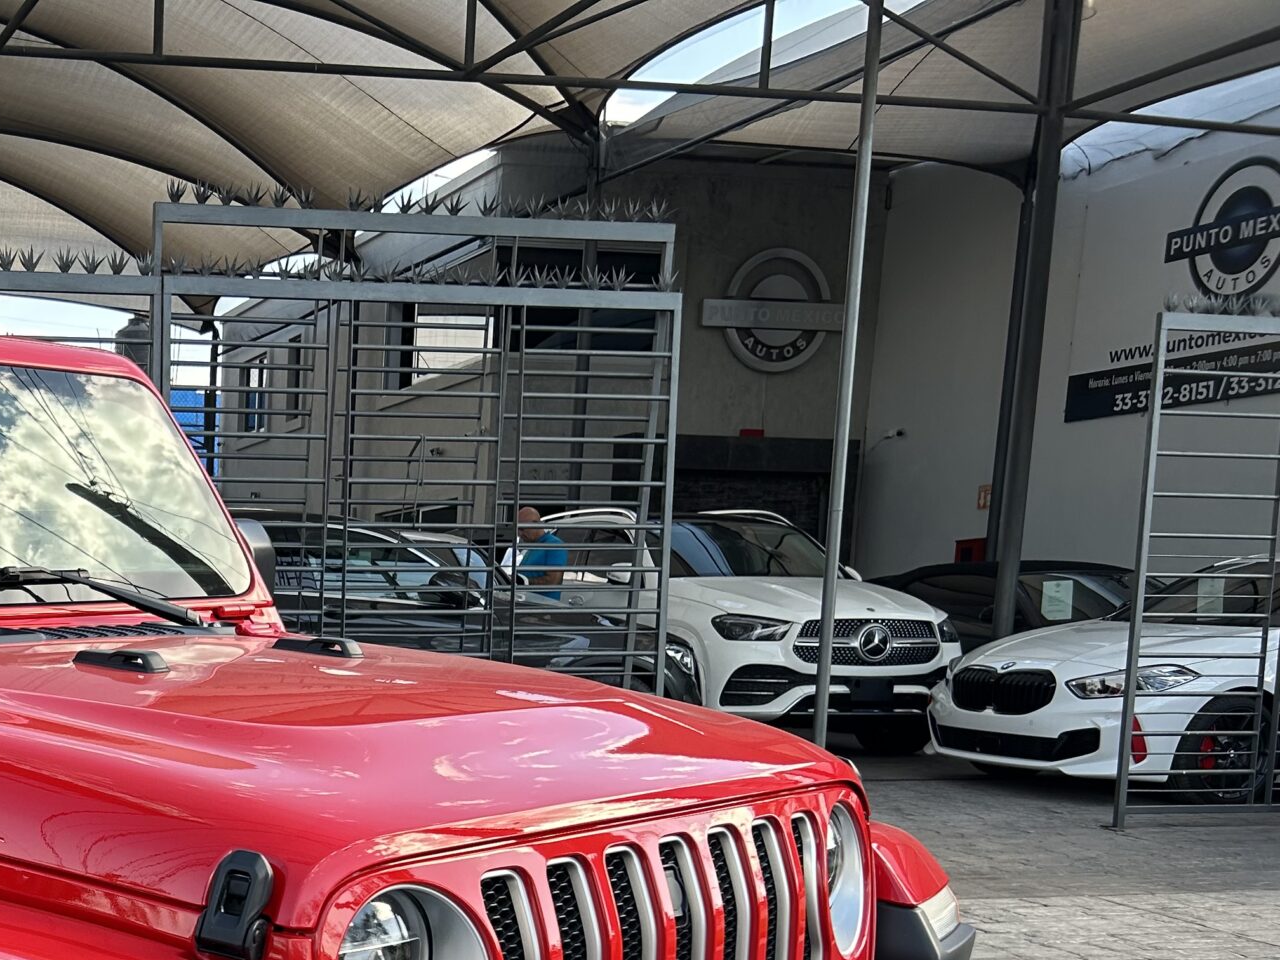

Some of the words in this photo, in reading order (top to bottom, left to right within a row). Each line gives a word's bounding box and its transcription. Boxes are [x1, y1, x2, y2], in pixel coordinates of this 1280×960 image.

[1170, 224, 1232, 256] PUNTO
[1202, 255, 1271, 291] AUTOS
[744, 335, 807, 361] AUTOS
[1111, 374, 1128, 386] Lunes
